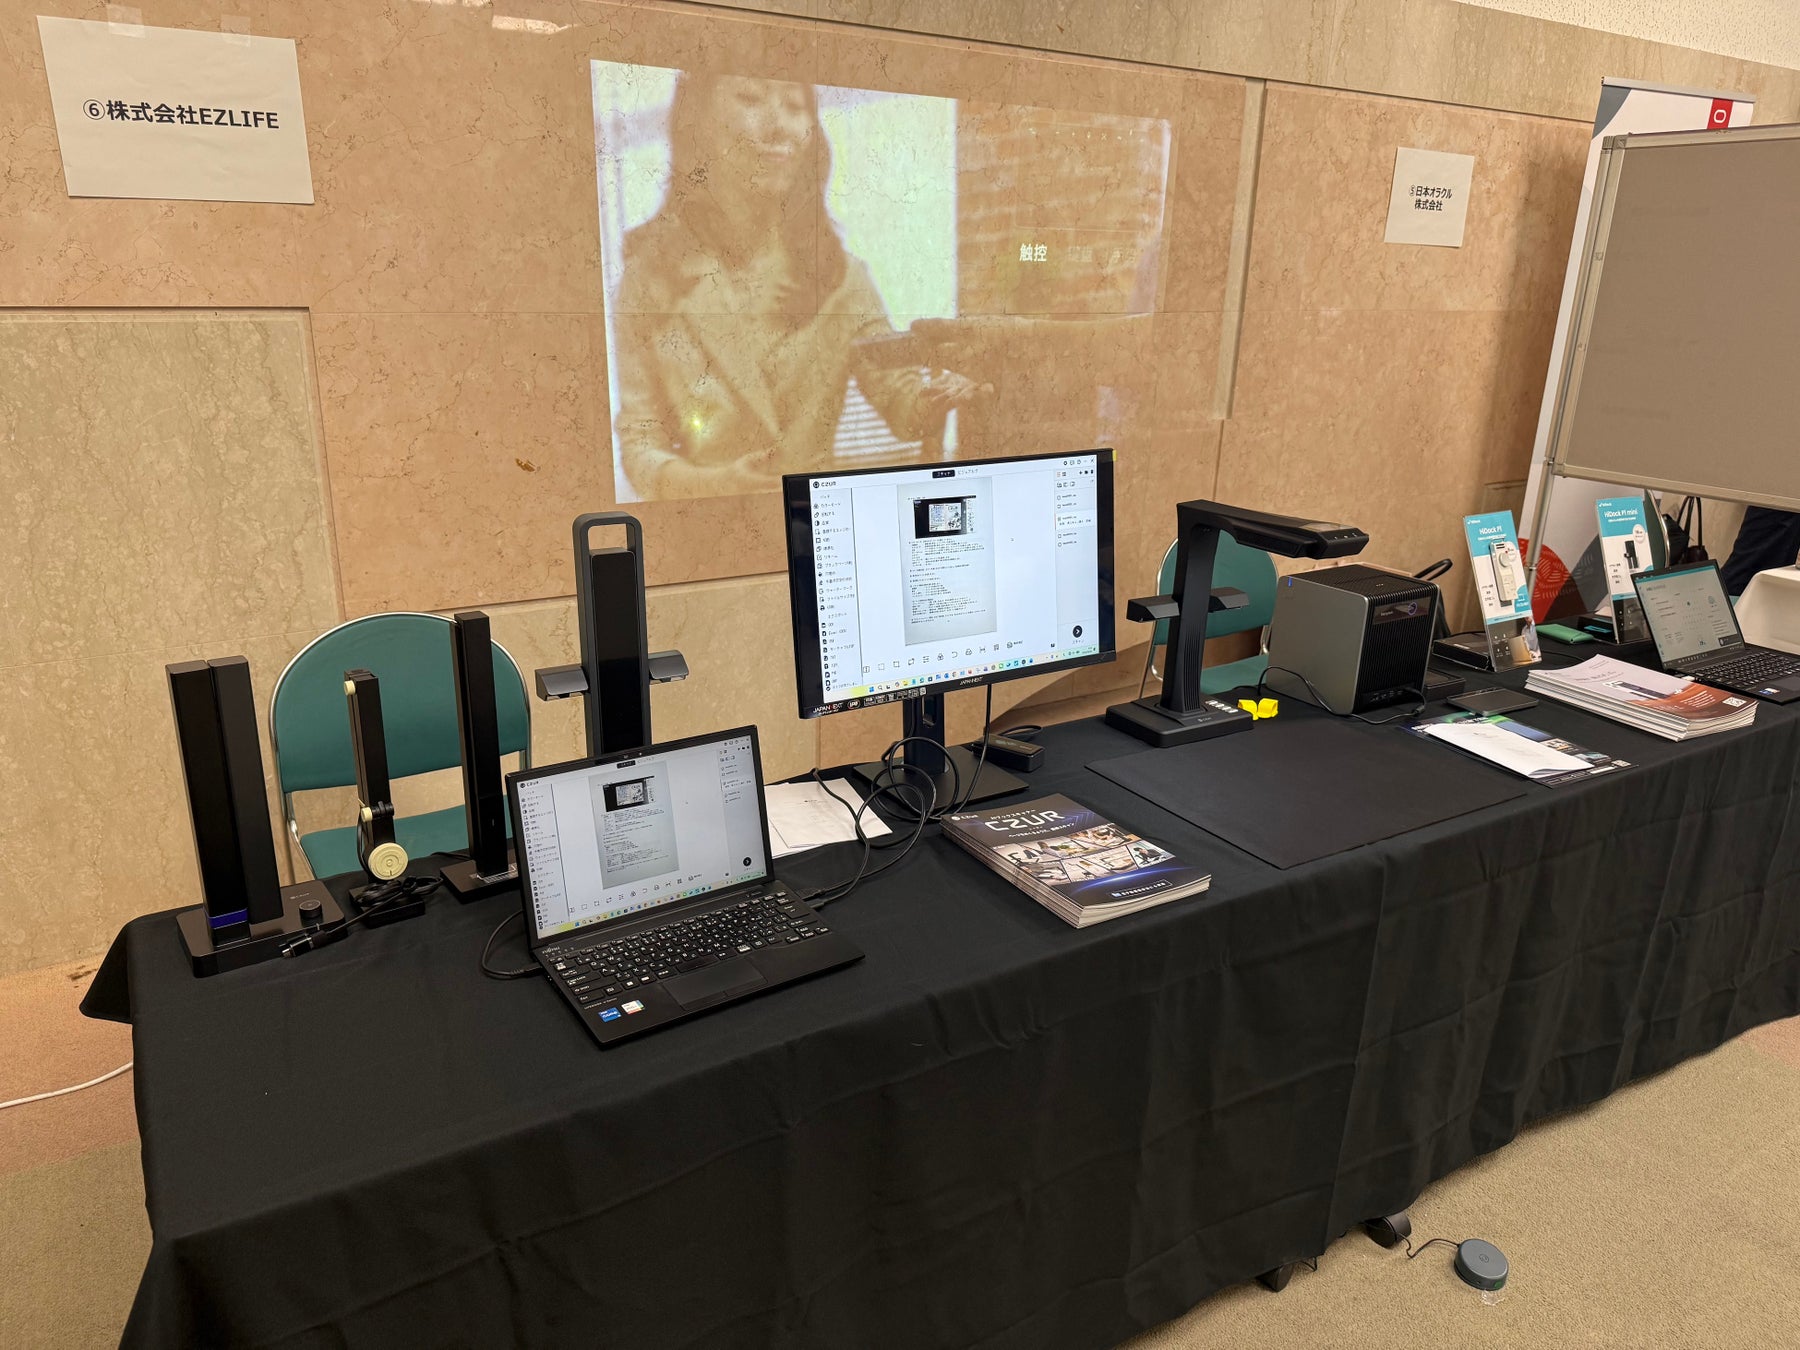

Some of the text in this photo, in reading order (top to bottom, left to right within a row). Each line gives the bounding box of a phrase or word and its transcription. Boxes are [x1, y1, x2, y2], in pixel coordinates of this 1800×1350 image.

[83, 99, 280, 129] ⑥株式会社EZLIFE
[1409, 185, 1453, 199] ⑤日本オラクル
[1414, 198, 1443, 211] 株式会社
[1019, 243, 1047, 262] 触控
[985, 810, 1065, 832] CZUR
